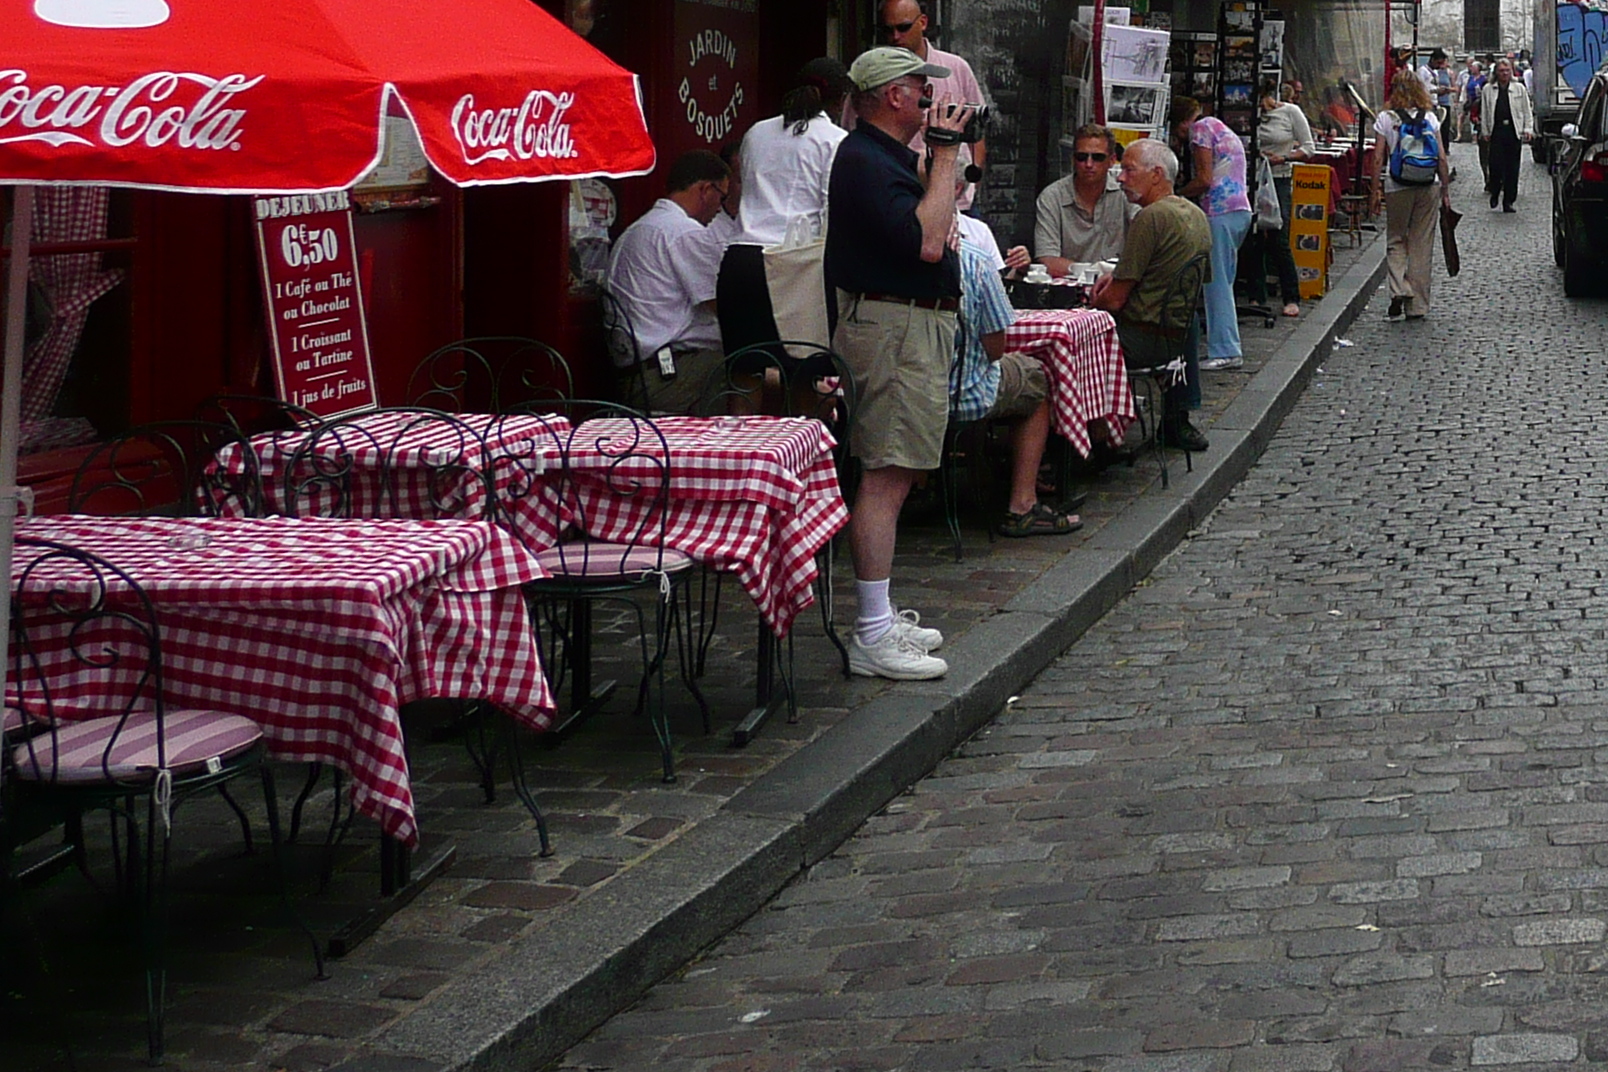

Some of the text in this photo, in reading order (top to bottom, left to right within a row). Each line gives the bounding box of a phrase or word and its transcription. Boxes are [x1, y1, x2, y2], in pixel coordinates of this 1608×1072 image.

[689, 29, 736, 70] JARDIN
[678, 76, 744, 144] BOSQUETS
[452, 90, 575, 165] Coca-Cola
[1295, 179, 1326, 190] Kodak
[285, 278, 312, 299] Café
[315, 280, 329, 292] ou
[331, 272, 353, 289] Thé
[283, 295, 351, 320] ou Chocolat
[291, 329, 352, 353] 1 Croissant
[295, 349, 353, 372] ou Tartine
[301, 389, 319, 408] jus
[321, 383, 335, 399] de
[336, 377, 367, 400] fruits
